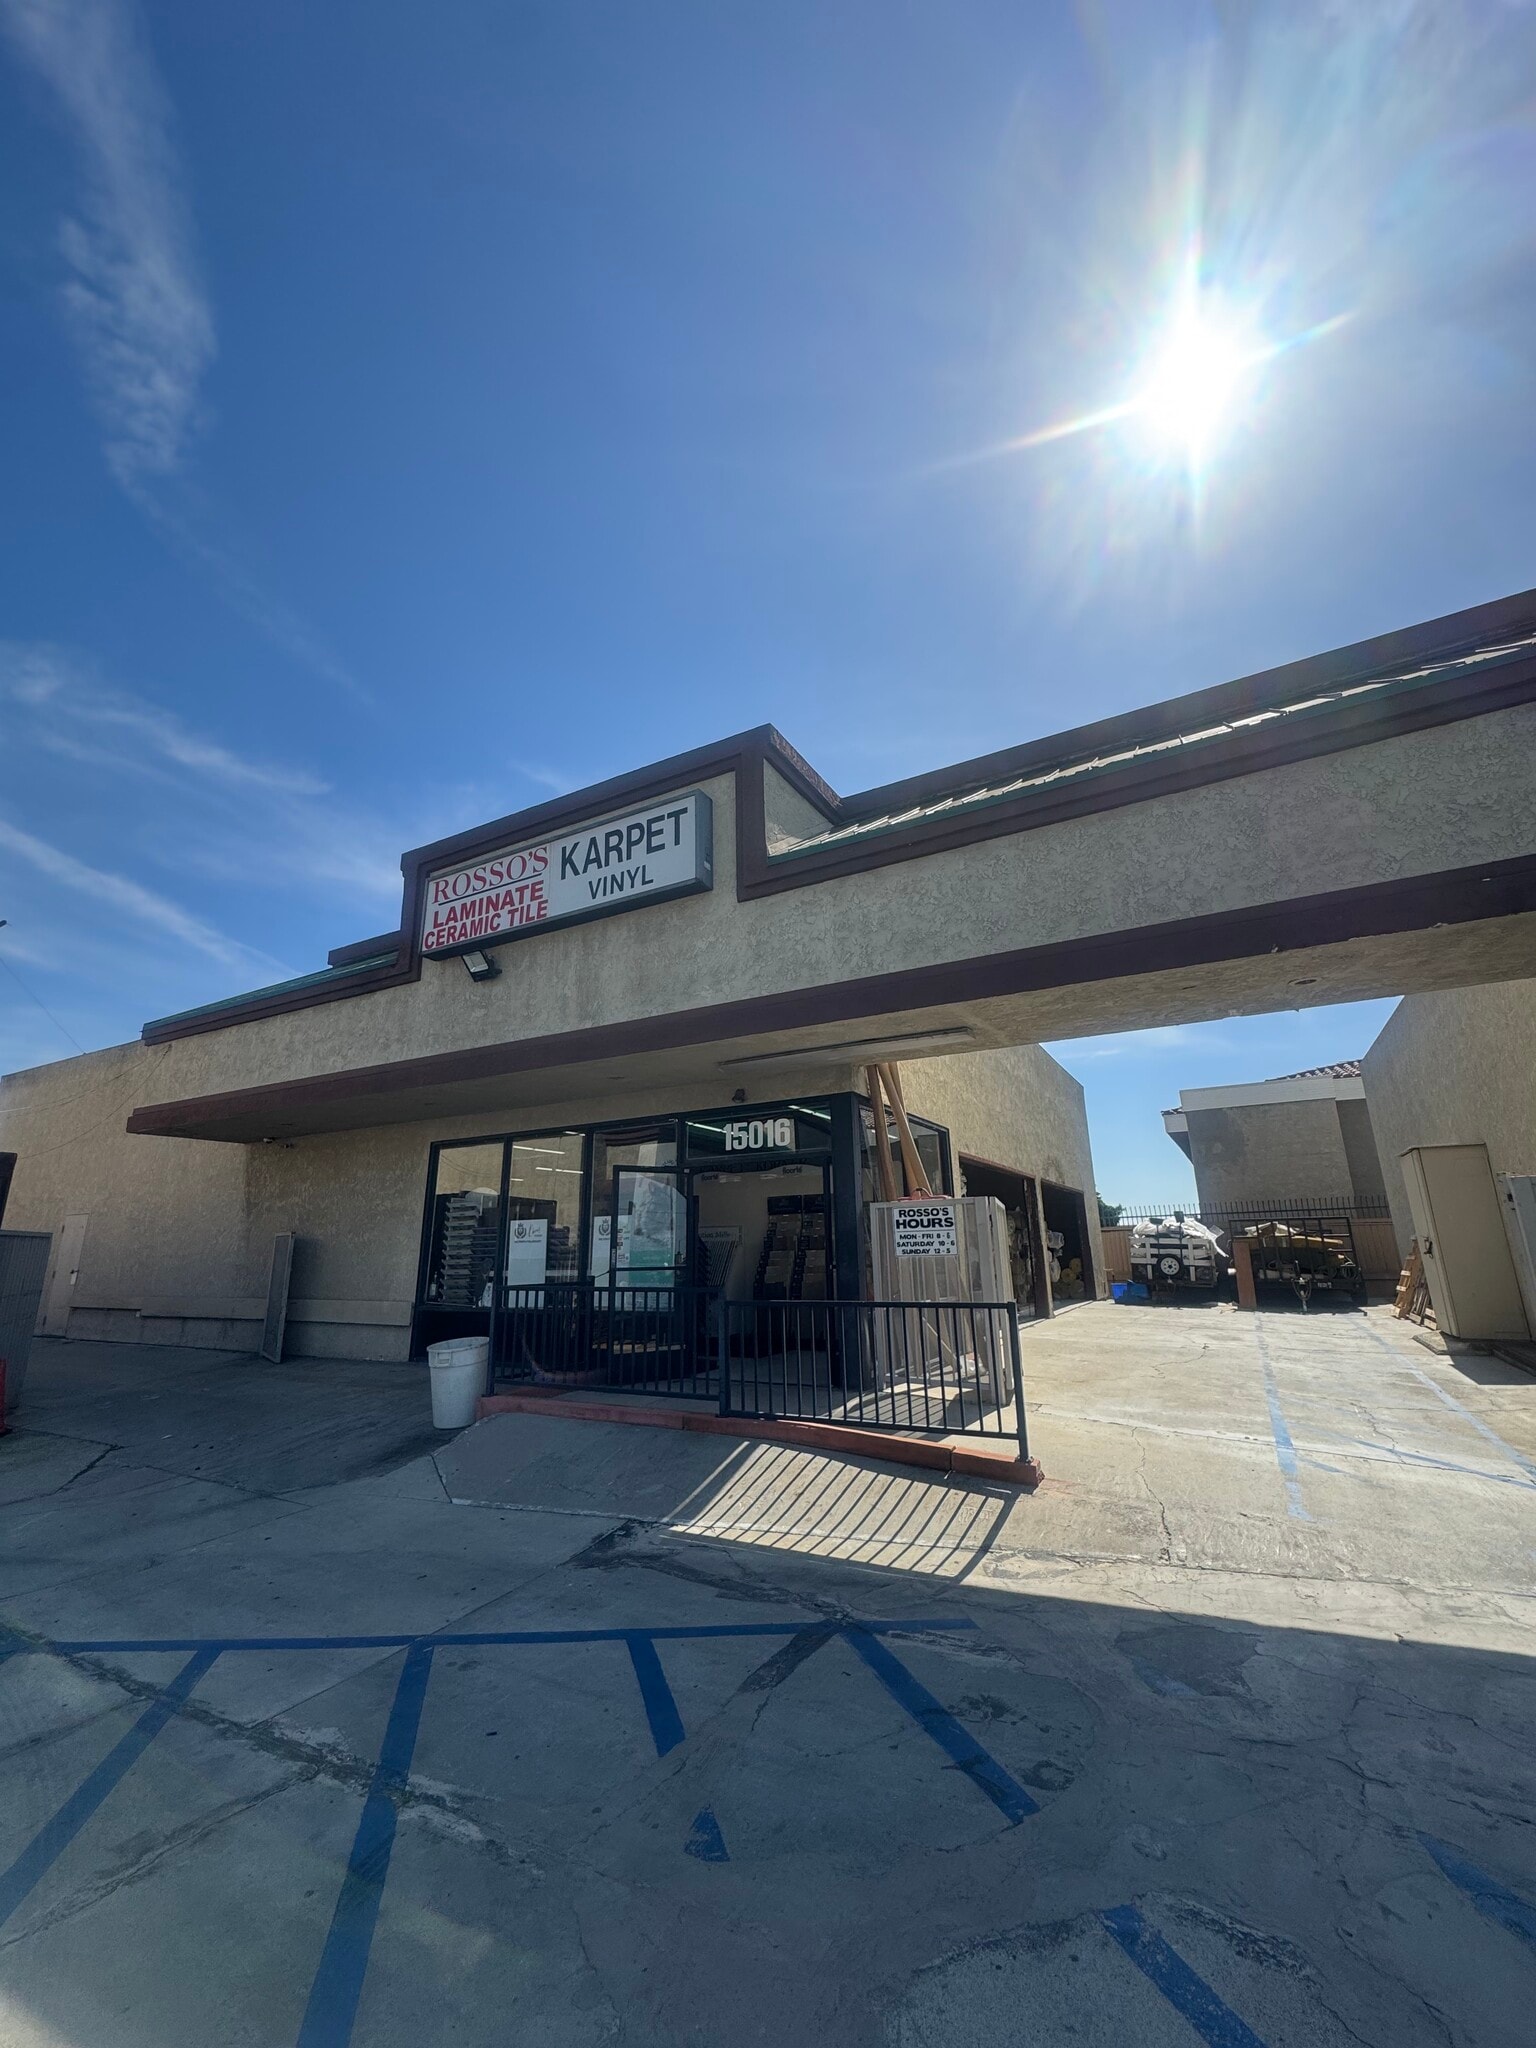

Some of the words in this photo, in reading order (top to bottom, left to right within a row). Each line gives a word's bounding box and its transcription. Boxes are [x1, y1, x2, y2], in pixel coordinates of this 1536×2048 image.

[560, 807, 688, 880] KARPET
[433, 846, 549, 904] ROSSO'S
[588, 864, 654, 899] VINYL
[424, 913, 501, 950] CERAMIC
[508, 899, 549, 927] TILE
[433, 880, 544, 929] LAMINATE
[723, 1118, 791, 1151] 15016
[896, 1217, 954, 1229] HOURS
[898, 1207, 949, 1218] ROSSO'S
